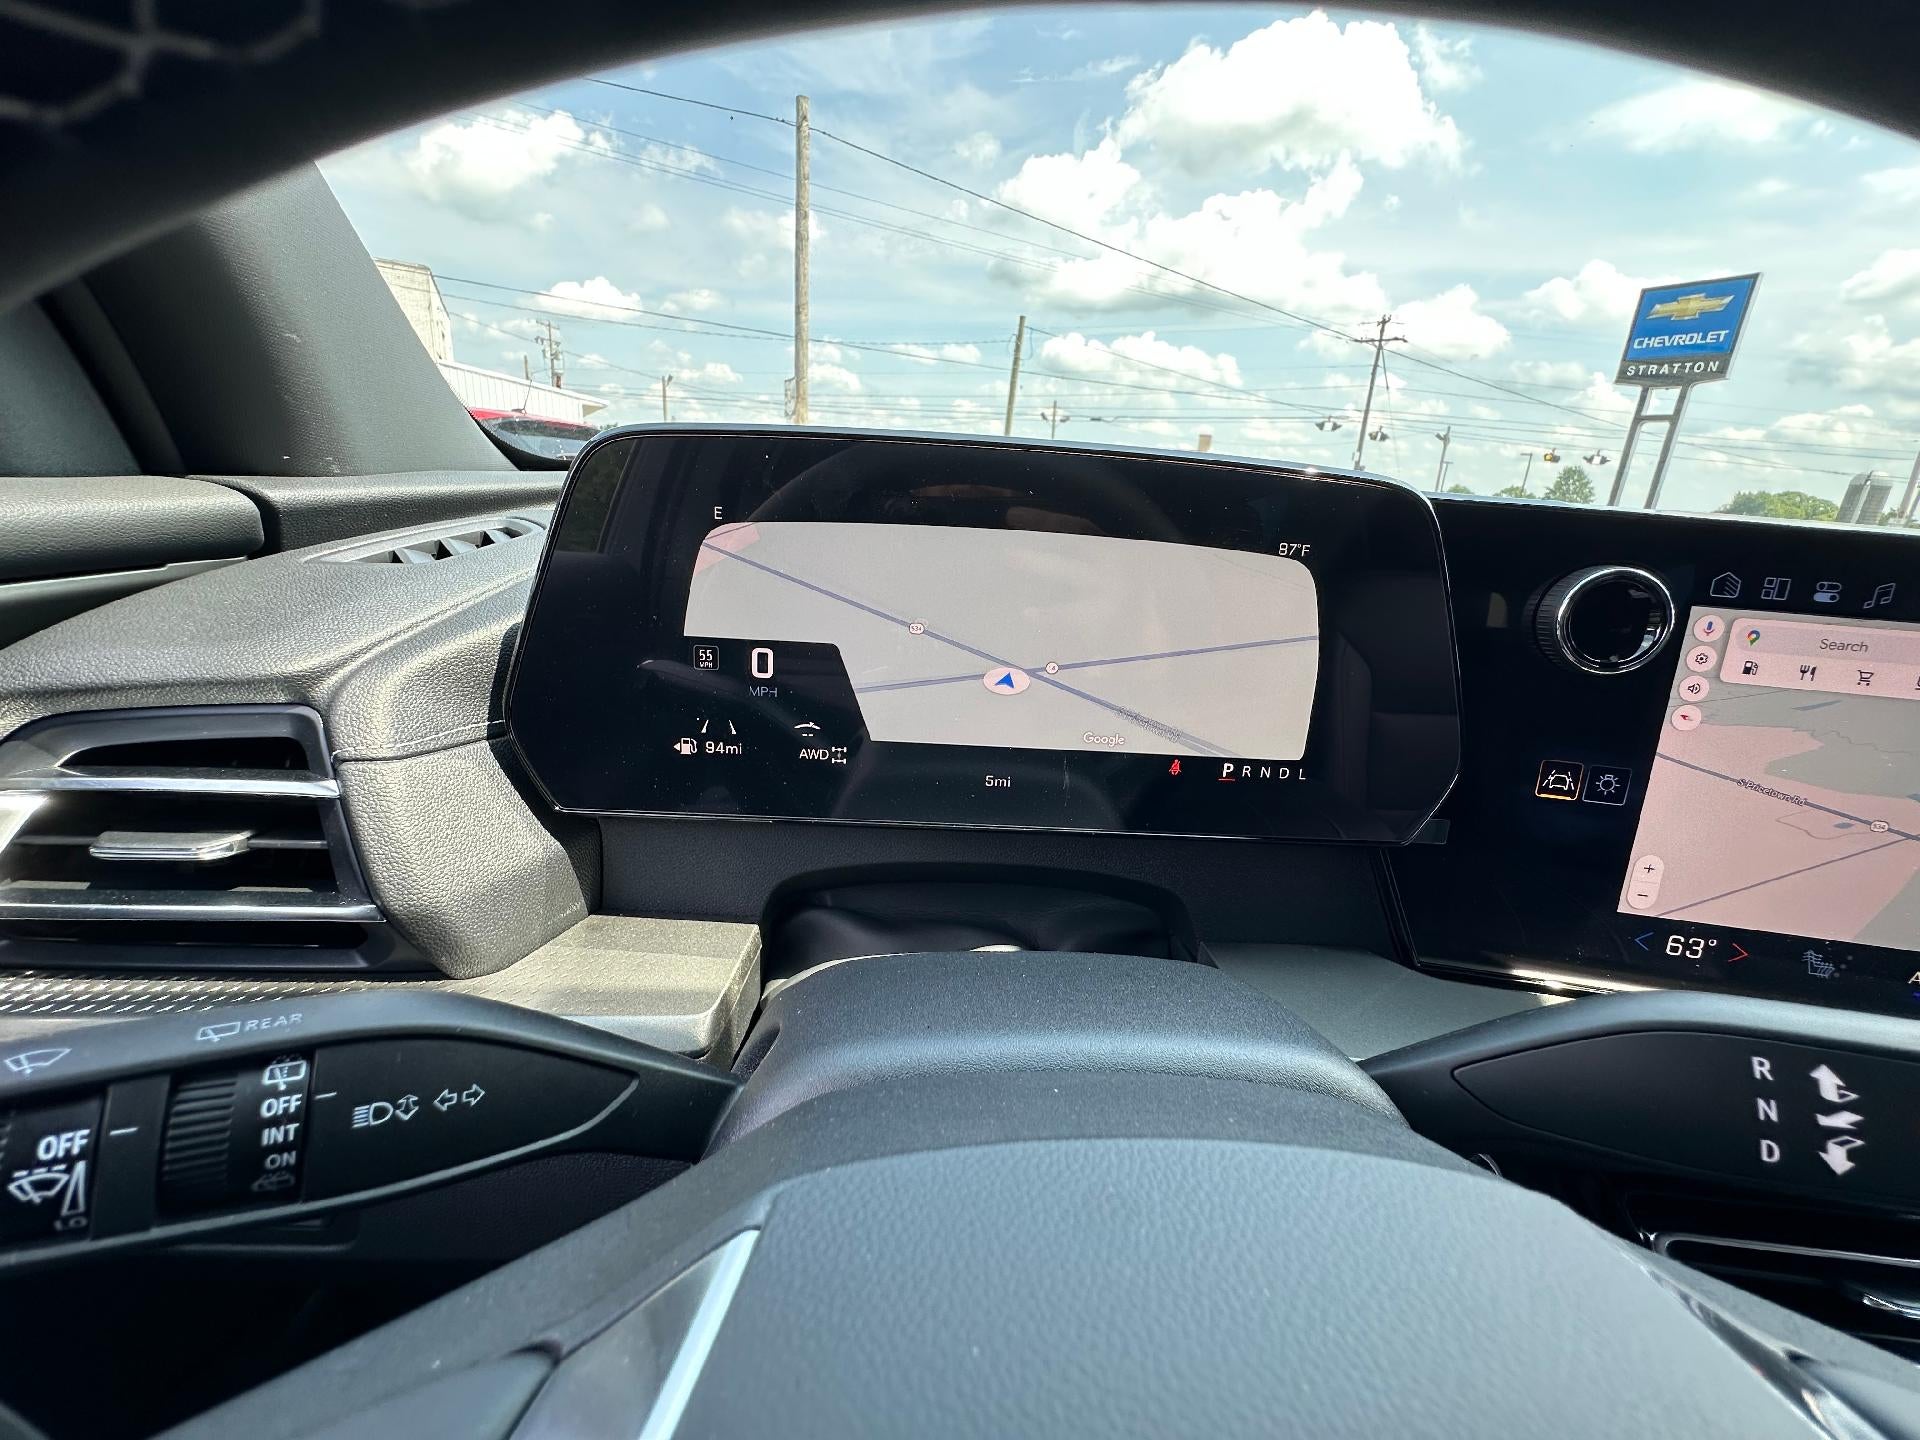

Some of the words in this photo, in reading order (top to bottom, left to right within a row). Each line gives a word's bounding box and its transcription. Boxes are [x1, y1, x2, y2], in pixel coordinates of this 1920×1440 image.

[1633, 329, 1730, 349] CHEVROLET
[1626, 361, 1720, 376] STRATTON
[714, 506, 723, 520] E
[699, 649, 713, 661] 55
[1819, 638, 1869, 654] Search
[751, 647, 774, 679] 0
[749, 686, 778, 697] MPH
[705, 741, 742, 754] 94mi
[1083, 731, 1125, 746] Google
[799, 748, 829, 761] AWD
[1222, 762, 1235, 778] P
[1242, 765, 1251, 778] R
[1260, 766, 1271, 778] N
[1279, 767, 1290, 779] D
[1298, 768, 1307, 780] L
[985, 775, 1011, 788] 5mi
[1737, 779, 1745, 788] S
[244, 1013, 303, 1031] REAR
[1750, 1056, 1774, 1081] R
[260, 1095, 302, 1118] OFF
[1756, 1097, 1778, 1123] N
[261, 1124, 298, 1145] INT
[37, 1128, 91, 1160] OFF
[1760, 1139, 1780, 1163] D
[264, 1151, 296, 1169] ON
